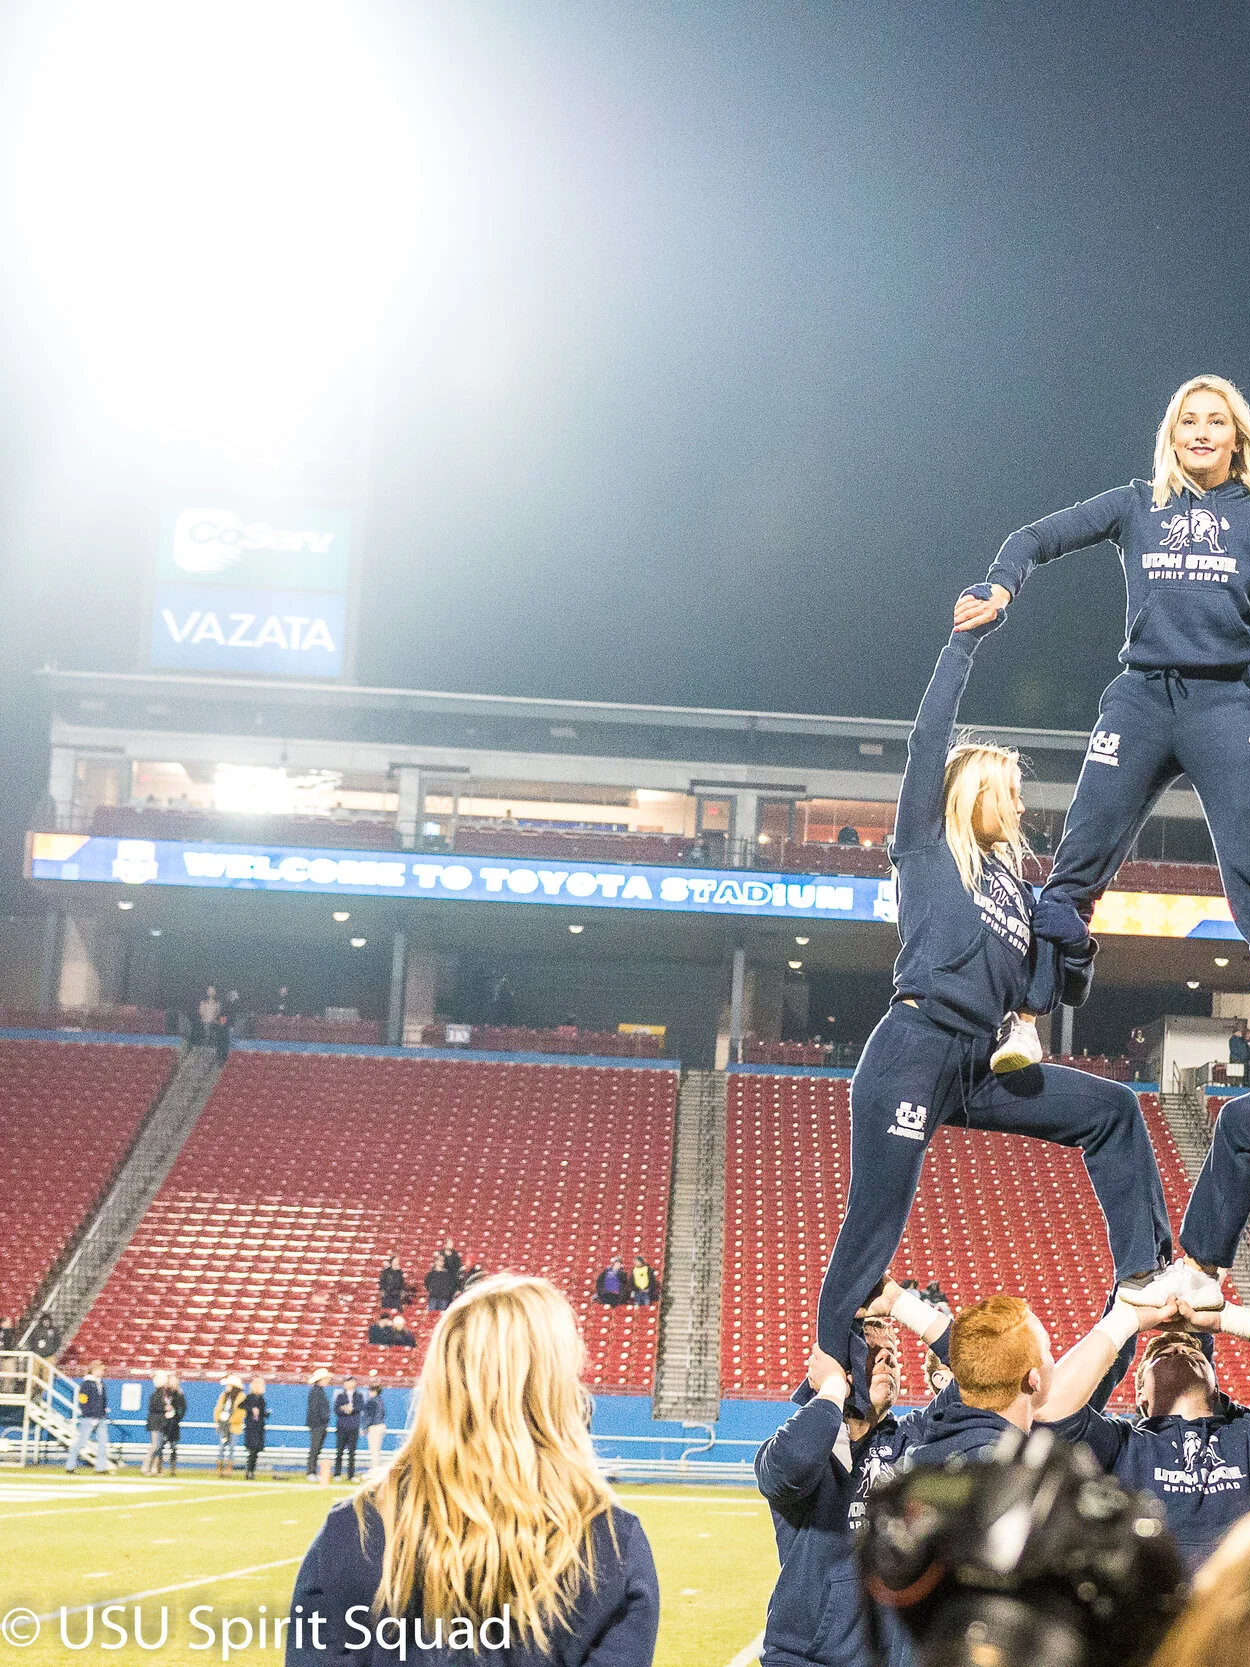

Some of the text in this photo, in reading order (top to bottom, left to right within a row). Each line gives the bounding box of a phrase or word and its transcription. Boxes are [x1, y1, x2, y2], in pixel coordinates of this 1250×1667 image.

[1142, 553, 1237, 573] UTAH STATE
[1148, 571, 1229, 583] SPIRIT SQUAD
[162, 608, 336, 653] VAZATA
[183, 852, 854, 911] WELCOME TO TOYOTA STADIUM
[980, 911, 1008, 938] SPIRIT
[1154, 1467, 1199, 1486] UTAH
[1163, 1484, 1203, 1494] SPIRIT
